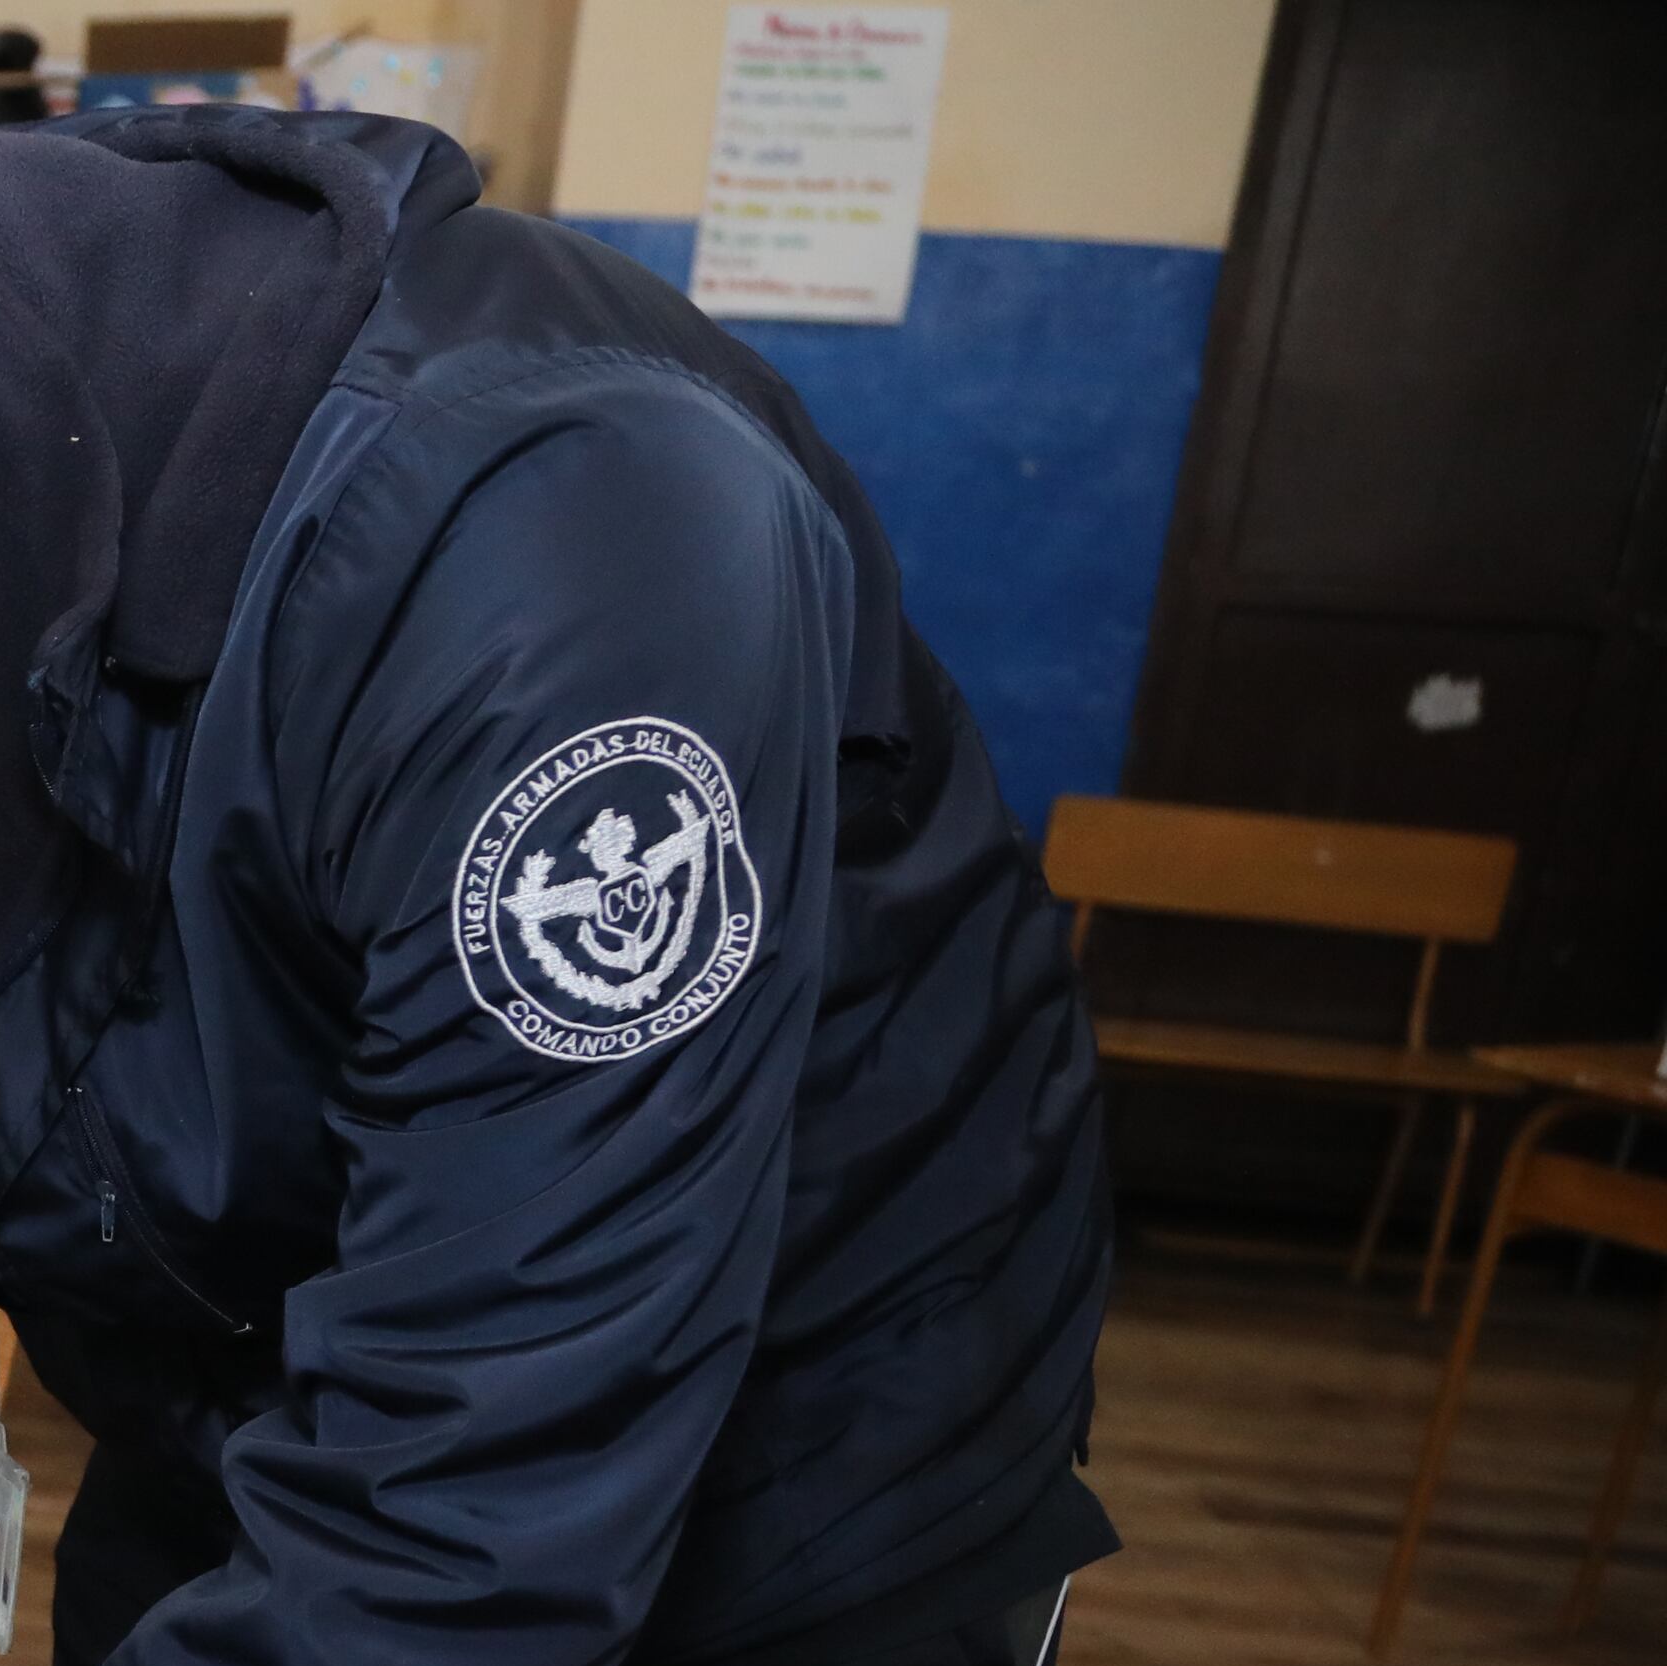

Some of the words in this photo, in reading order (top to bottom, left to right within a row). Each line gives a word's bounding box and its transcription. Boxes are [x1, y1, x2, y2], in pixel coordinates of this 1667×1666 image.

[463, 837, 504, 956] FUERZAS
[501, 733, 625, 828] ARMADAS
[635, 729, 675, 757] DEL
[675, 744, 735, 845] ECUADOR
[507, 999, 642, 1057] COMANDO
[648, 912, 750, 1036] CONJUNTO
